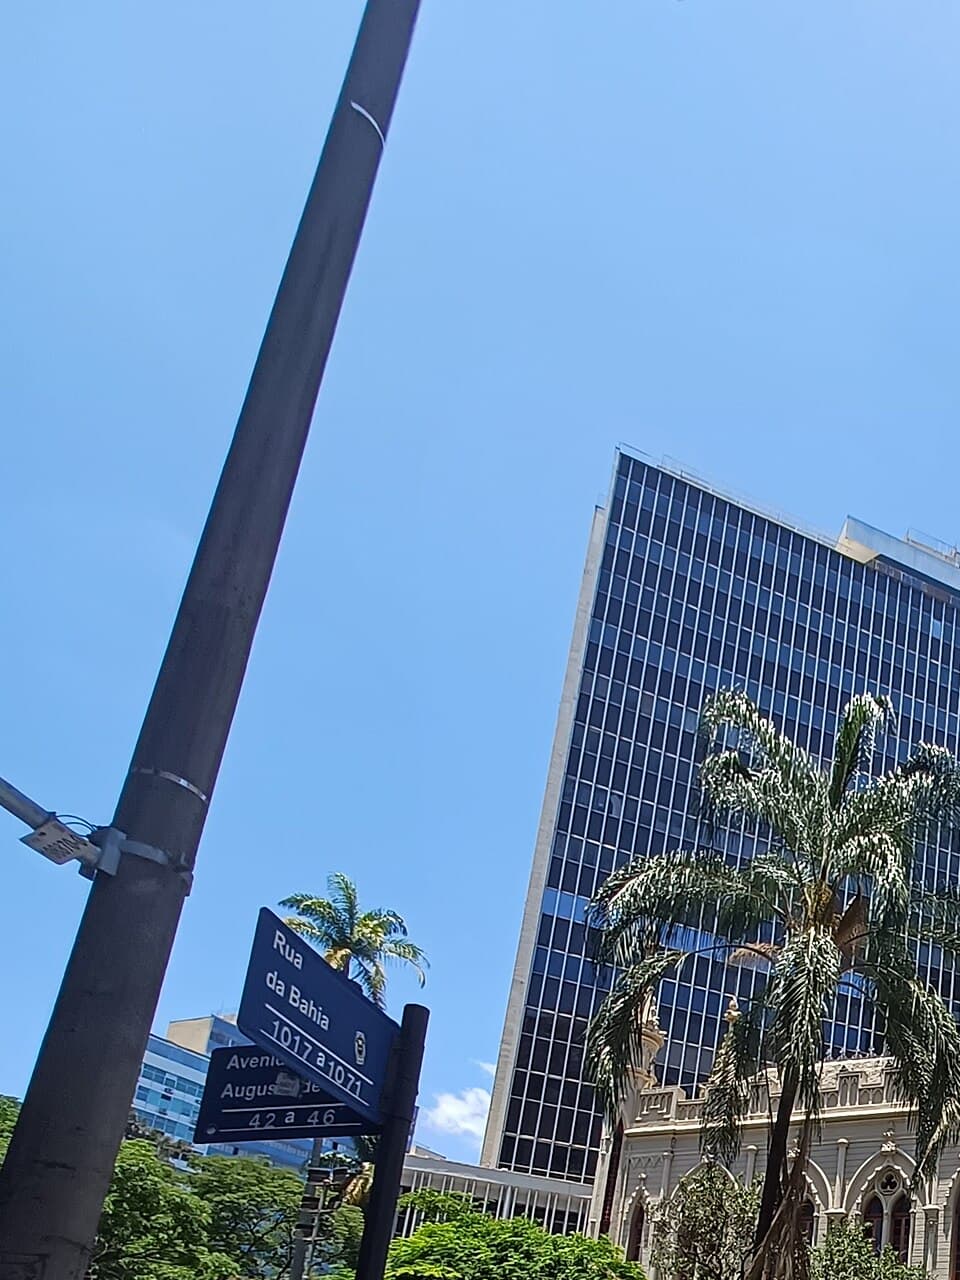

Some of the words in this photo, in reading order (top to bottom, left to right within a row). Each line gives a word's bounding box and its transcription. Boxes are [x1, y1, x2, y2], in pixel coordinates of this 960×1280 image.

[272, 929, 304, 970] Rua
[265, 970, 286, 997] da
[288, 985, 330, 1031] Bahia
[226, 1055, 285, 1070] Aveni
[272, 1020, 312, 1060] 1017
[316, 1052, 326, 1068] a
[328, 1061, 362, 1097] 1071
[220, 1083, 280, 1101] Augus
[248, 1112, 276, 1129] 42
[284, 1111, 295, 1123] a
[307, 1109, 336, 1126] 46
